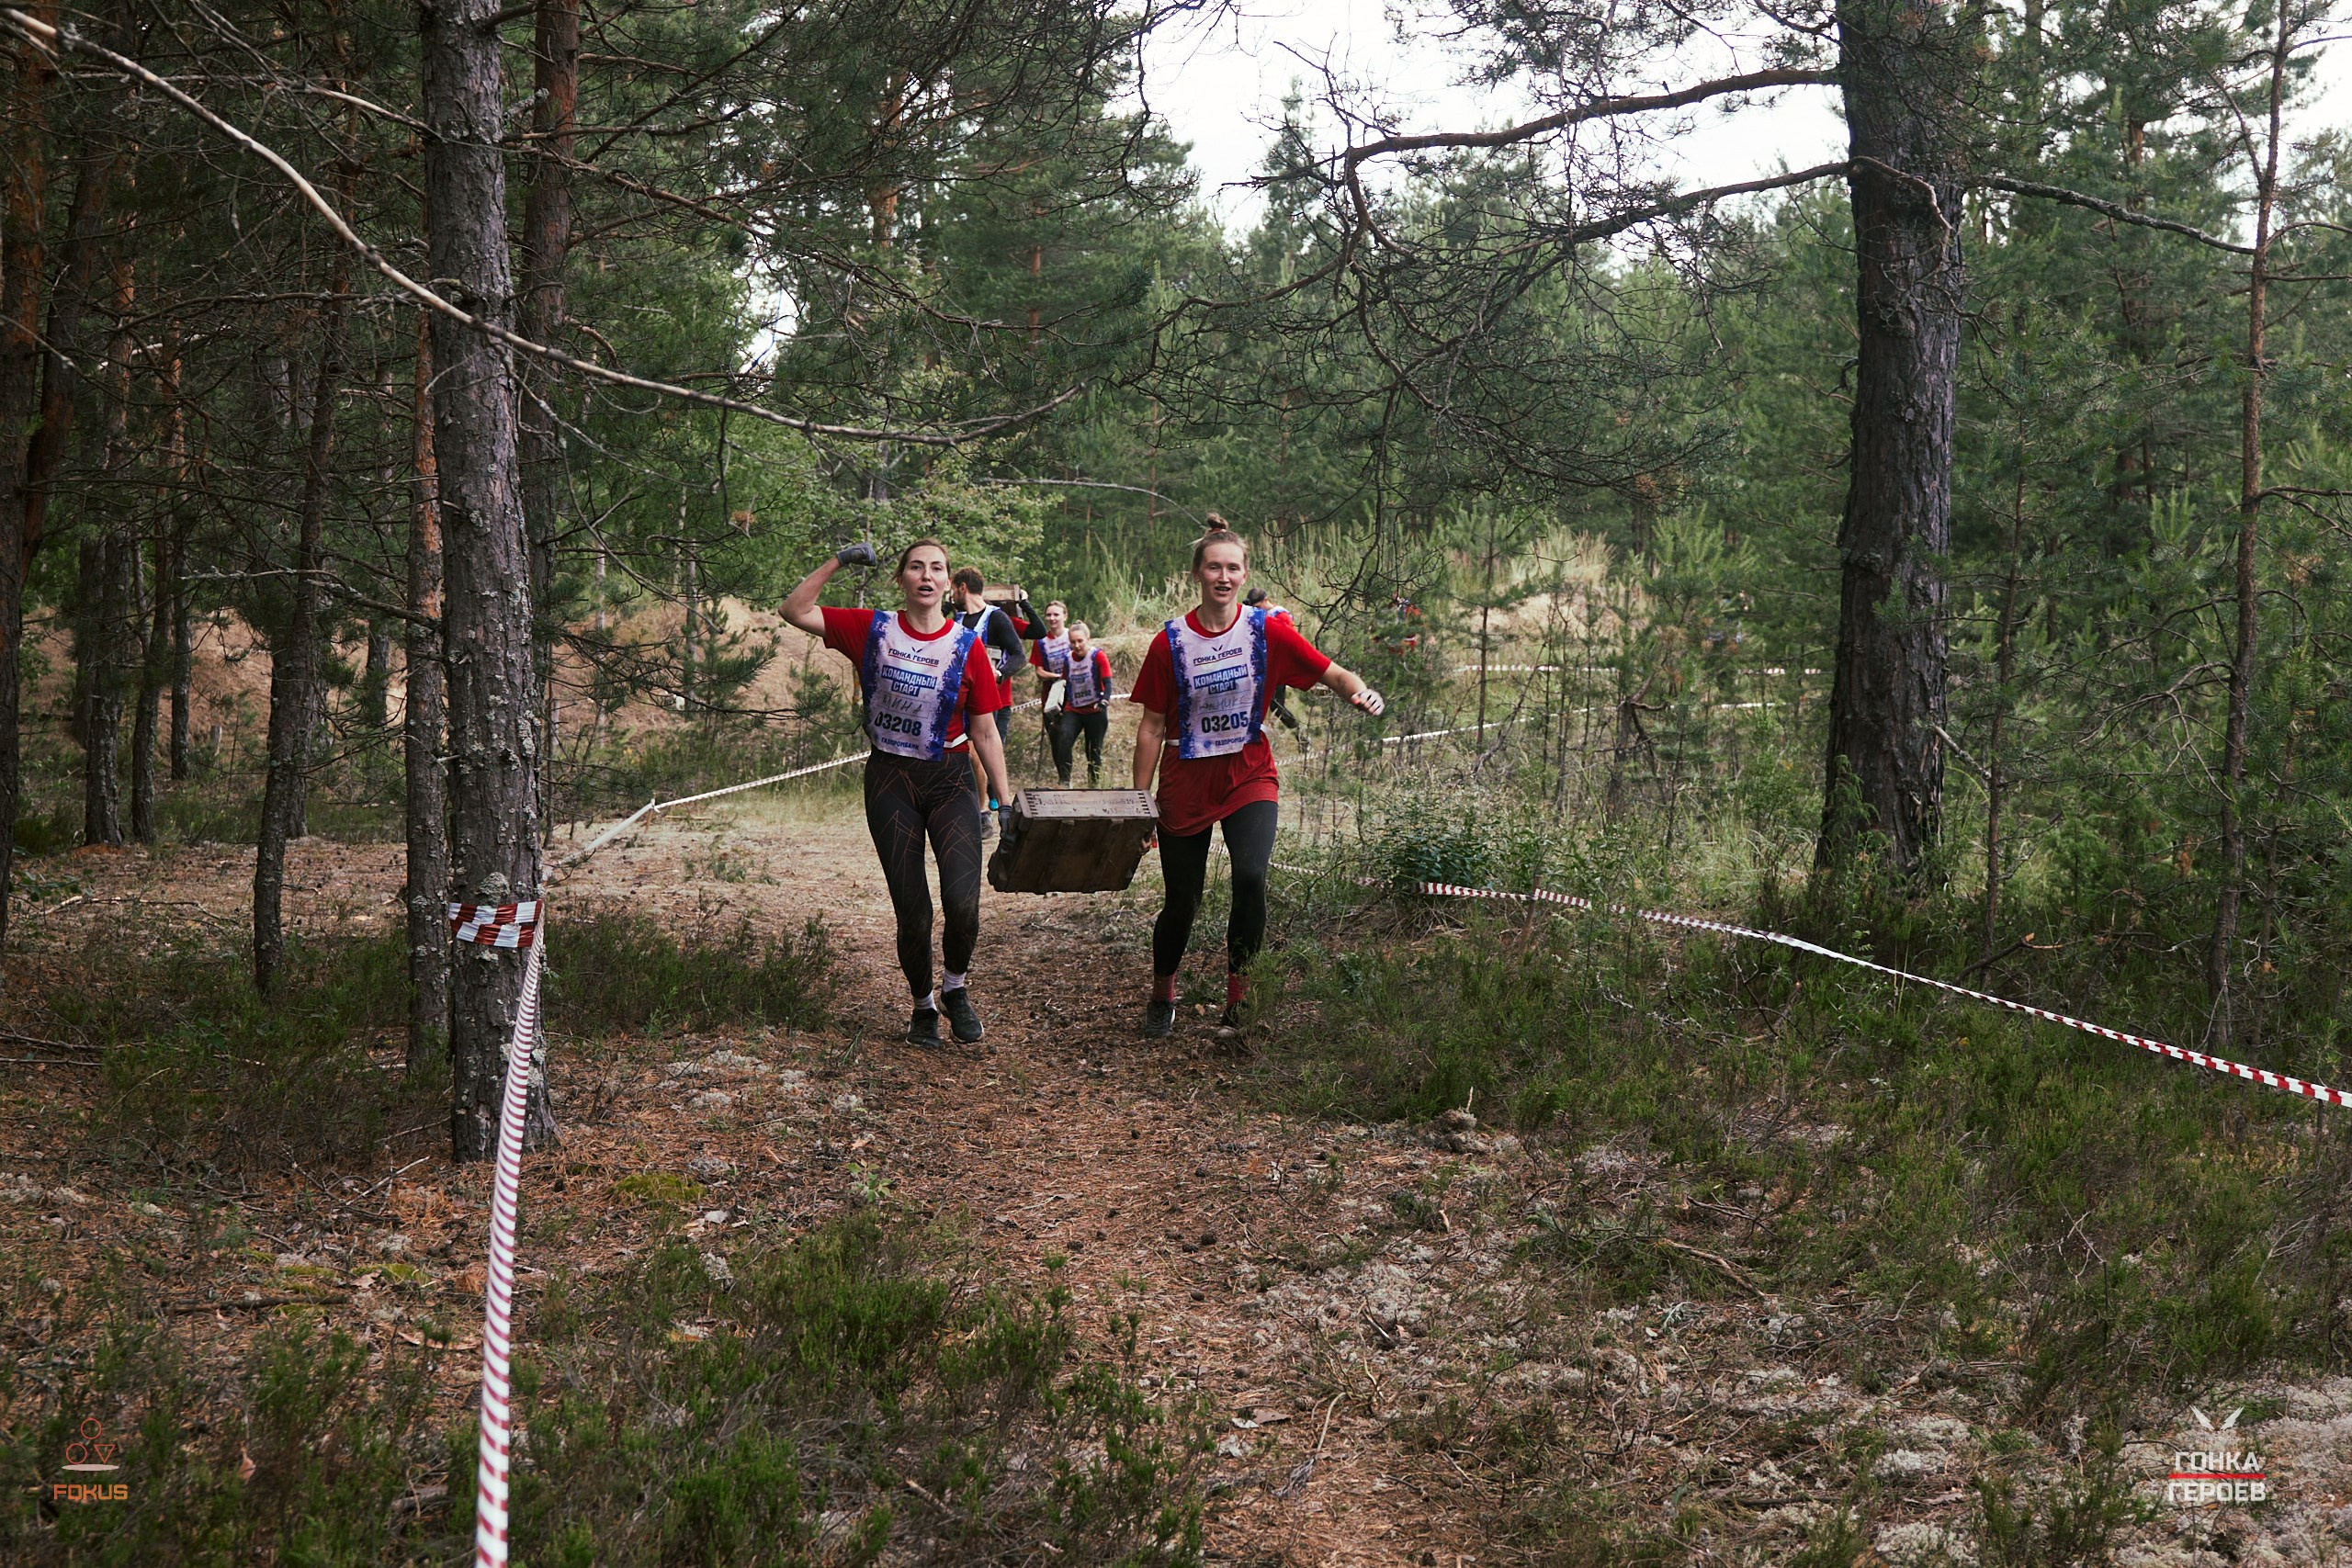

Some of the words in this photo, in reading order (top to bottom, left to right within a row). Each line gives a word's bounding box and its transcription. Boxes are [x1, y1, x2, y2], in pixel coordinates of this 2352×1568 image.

[888, 649, 911, 660] ГОНКА
[912, 655, 939, 666] ГЕРОЕВ
[1193, 655, 1216, 664] ГОНКА
[1217, 648, 1243, 659] ГЕРОЕВ
[882, 667, 936, 688] КОМАНДНЫЙ
[1194, 664, 1248, 688] КОМАНДНЫЙ
[892, 681, 919, 695] СТАРТ
[1209, 681, 1236, 694] СТАРТ
[875, 711, 922, 737] 03208
[1201, 711, 1249, 734] 03205
[881, 738, 920, 750] ГАЗПРОМБАНК
